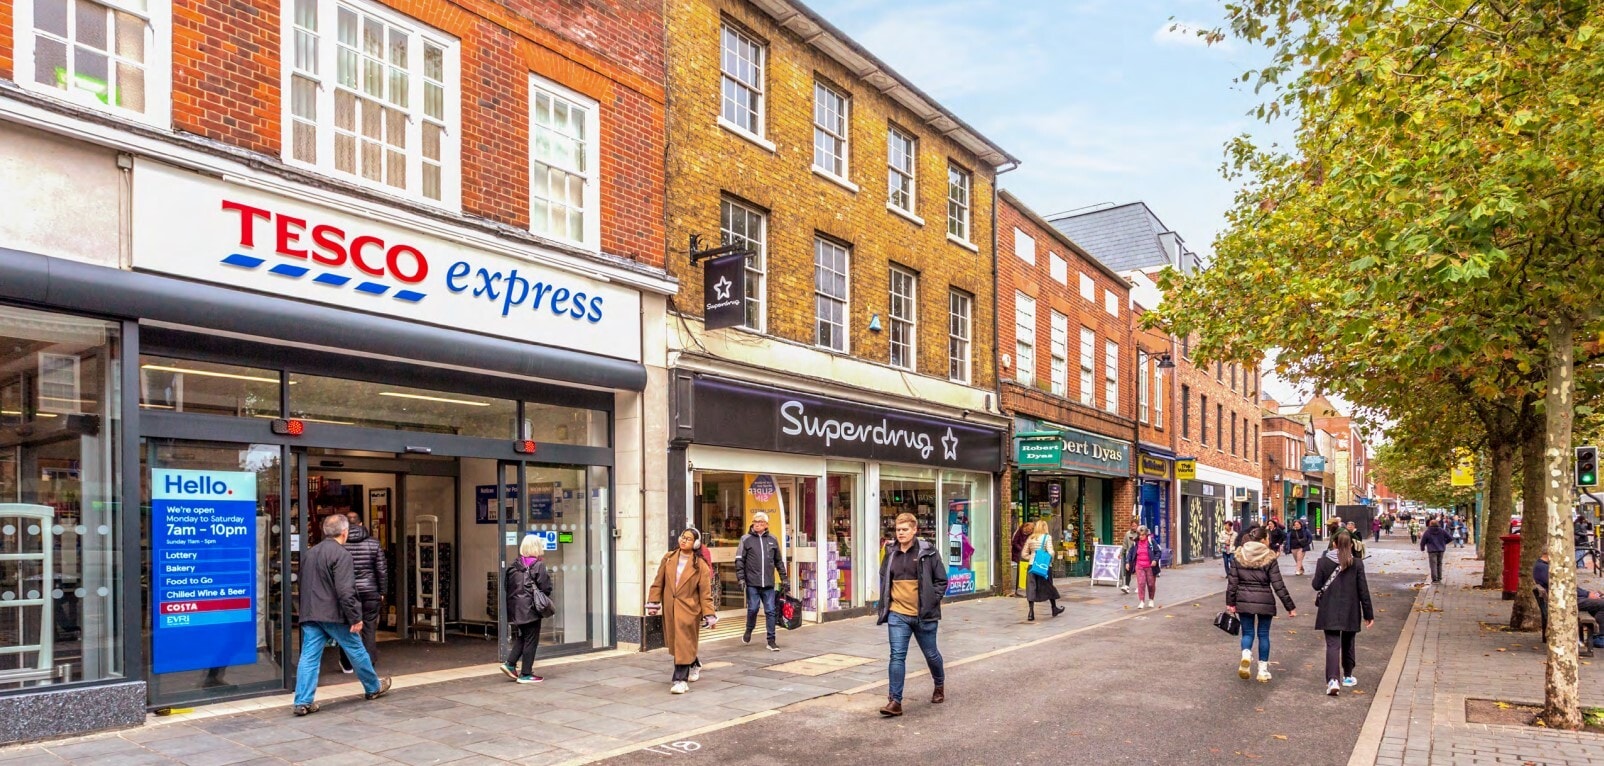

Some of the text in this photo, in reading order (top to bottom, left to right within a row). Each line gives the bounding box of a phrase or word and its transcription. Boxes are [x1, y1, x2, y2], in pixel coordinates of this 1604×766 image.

[221, 199, 604, 324] TESCO express
[706, 300, 740, 310] Superdrug
[780, 400, 934, 460] Superdrug
[1062, 440, 1123, 462] ert Dyas
[165, 474, 233, 495] Hello.
[166, 505, 215, 515] We're open
[166, 515, 198, 523] Monday
[210, 515, 245, 524] Saturday
[166, 523, 196, 536] 7am
[210, 523, 248, 538] 10pm
[165, 551, 198, 560] Lottery
[165, 565, 196, 573] Bakery
[166, 577, 188, 585] Food
[200, 576, 213, 584] Go
[950, 572, 972, 580] UNLIMITED
[950, 581, 961, 590] DATA
[166, 587, 246, 599] Chilled Wine & Beer
[166, 603, 198, 612] COSTA
